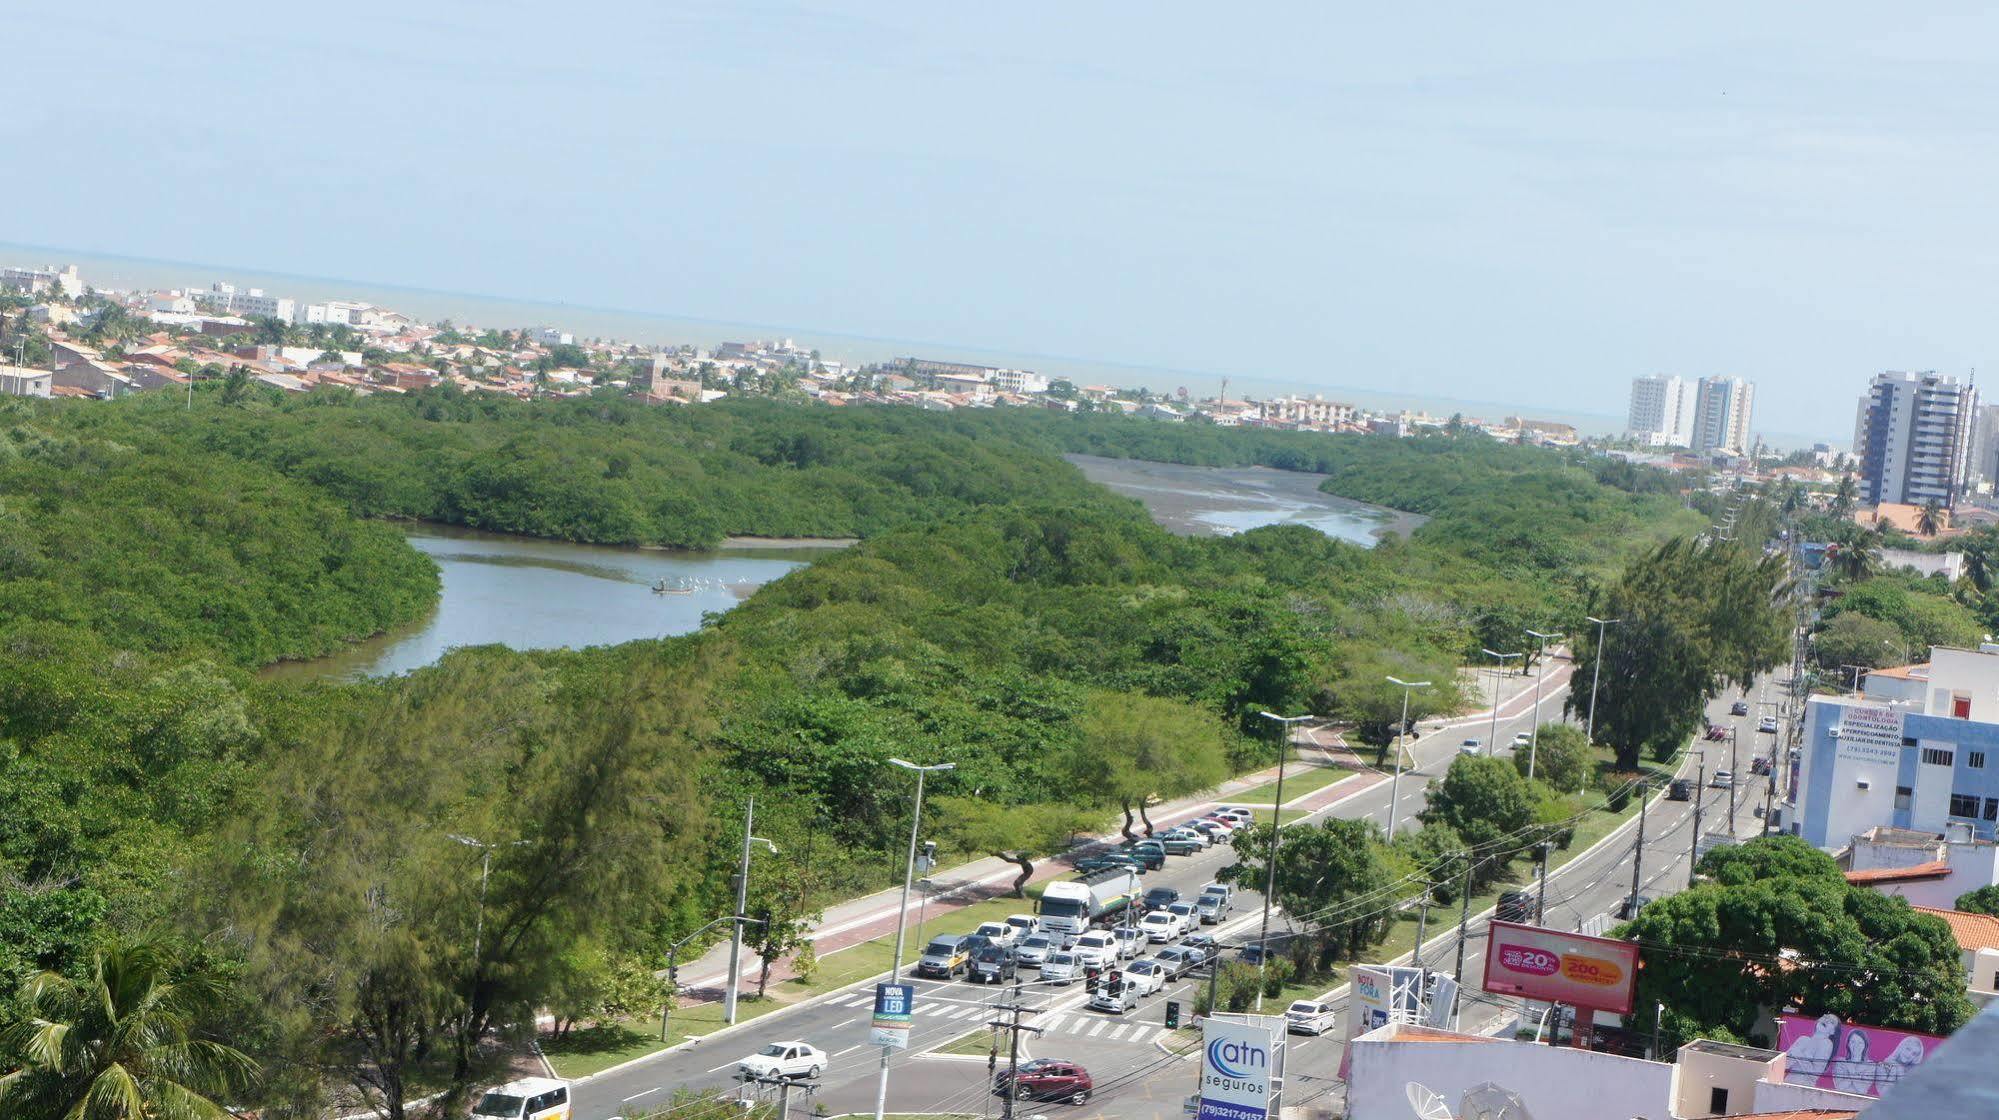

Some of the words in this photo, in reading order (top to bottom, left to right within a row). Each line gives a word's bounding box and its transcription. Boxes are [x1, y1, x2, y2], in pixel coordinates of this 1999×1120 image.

[1847, 713, 1898, 724] ODONTOLOGIA
[1843, 720, 1898, 732] ESPECIALIZAÇÃO
[1568, 961, 1599, 976] 200
[1358, 974, 1374, 985] BOTA
[884, 986, 904, 996] NOVA
[1360, 984, 1380, 998] FORA
[884, 1000, 904, 1013] LED
[1206, 1075, 1263, 1094] seguros
